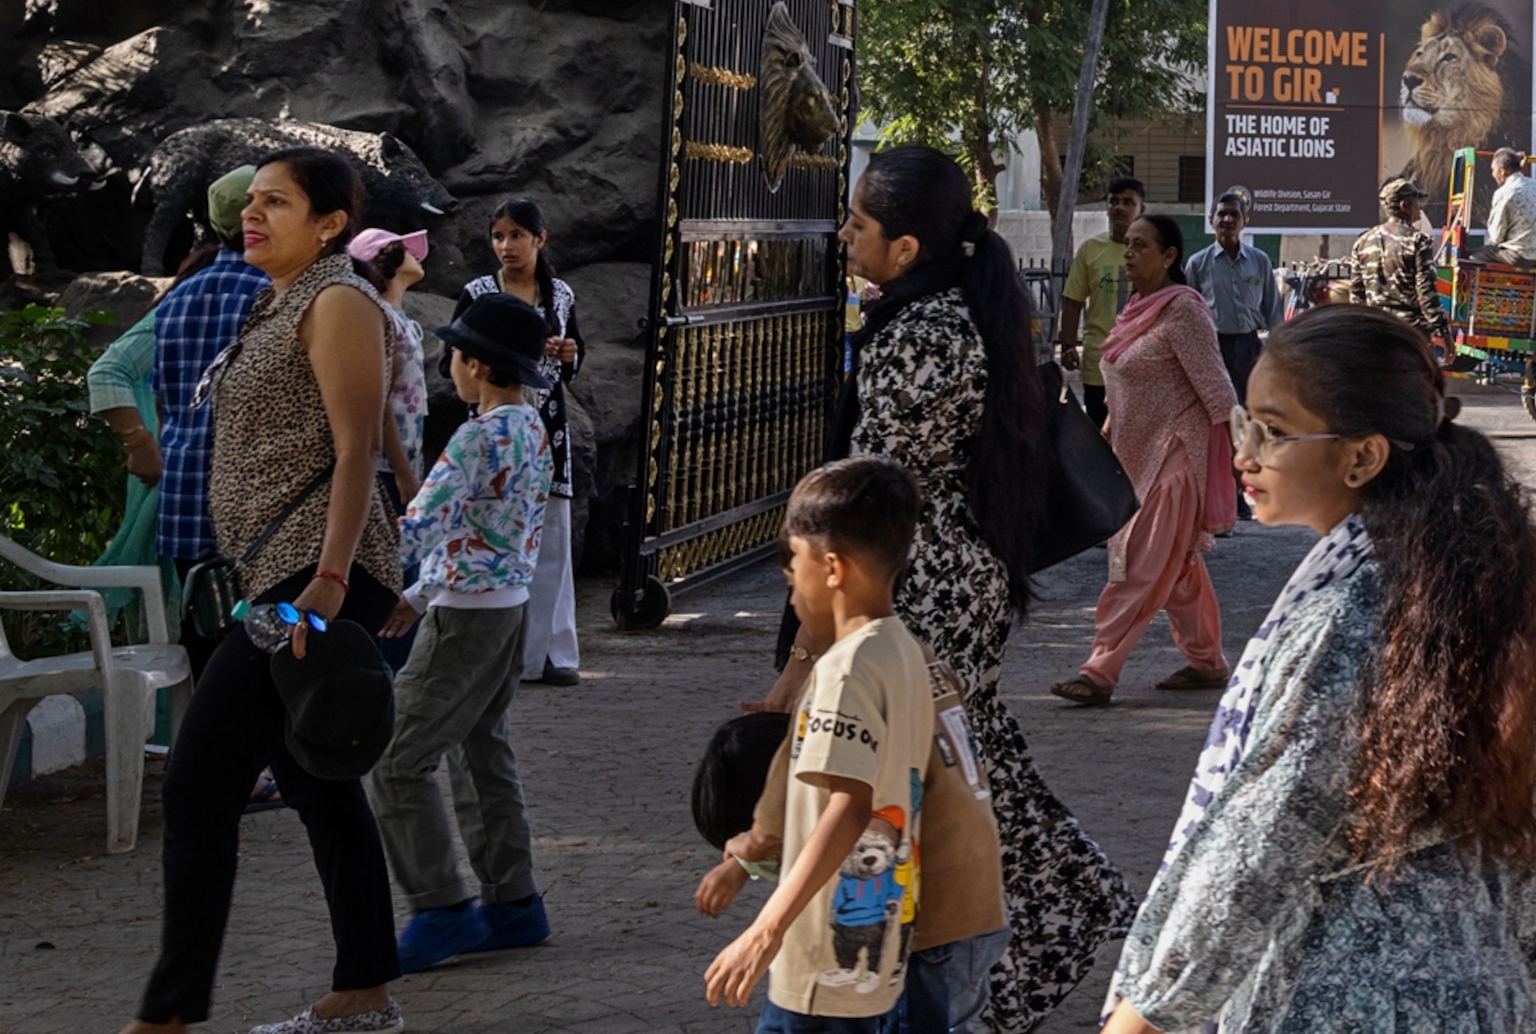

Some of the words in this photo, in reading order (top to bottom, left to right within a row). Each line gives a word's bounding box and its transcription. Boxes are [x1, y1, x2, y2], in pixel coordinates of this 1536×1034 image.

[1226, 26, 1368, 66] WELCOME
[1226, 65, 1264, 102] TO
[1225, 114, 1257, 134] THE
[1260, 115, 1306, 135] HOME
[1309, 116, 1330, 136] OF
[1225, 137, 1286, 157] ASIATIC
[1289, 138, 1335, 158] LIONS
[1253, 189, 1276, 198] Wildlife
[1277, 189, 1302, 199] Division,
[1303, 190, 1331, 199] Sasan-Gir
[1253, 203, 1273, 212] Forest
[1312, 204, 1334, 213] Gujarat
[1335, 204, 1351, 212] State
